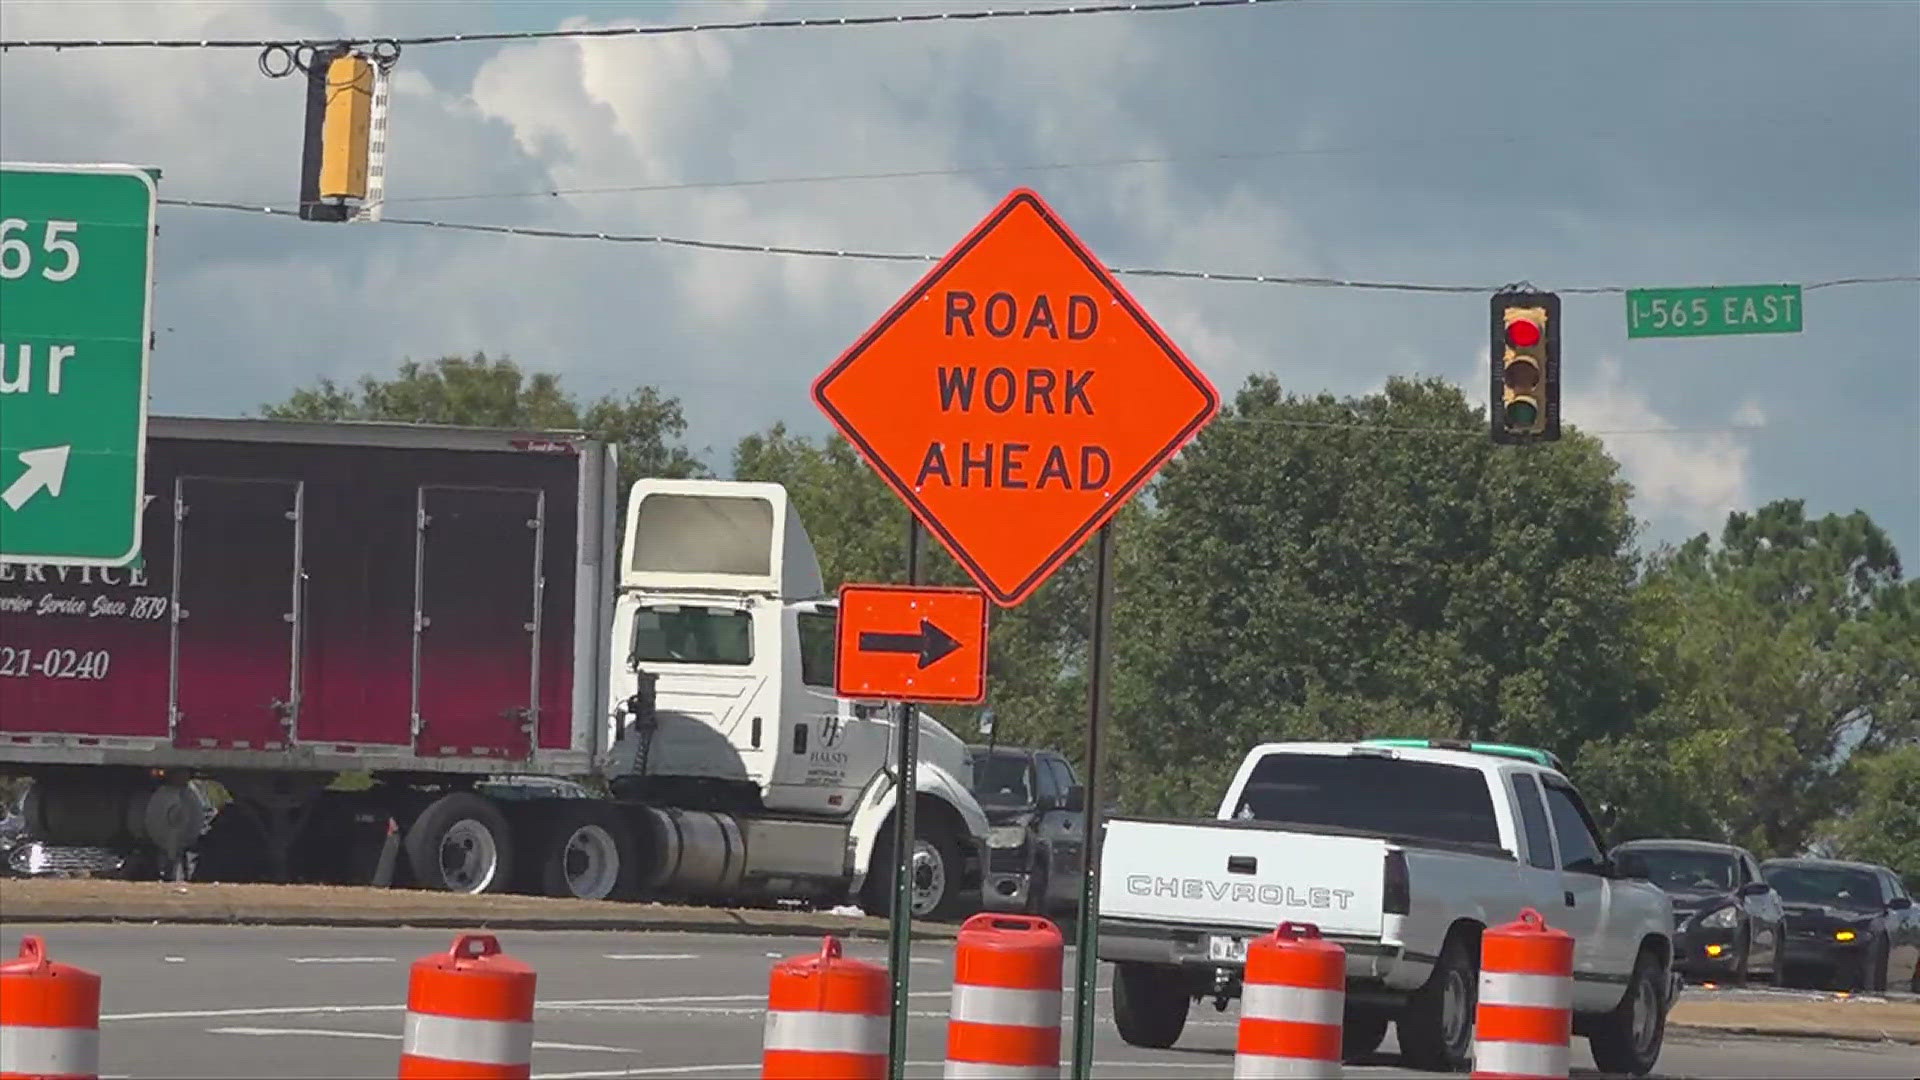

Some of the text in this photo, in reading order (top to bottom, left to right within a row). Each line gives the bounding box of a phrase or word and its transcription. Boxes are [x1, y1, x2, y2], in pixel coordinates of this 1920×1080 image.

[0, 218, 80, 282] 65
[945, 291, 1098, 340] ROAD
[1632, 295, 1795, 329] I-565 EAST
[0, 343, 76, 395] ur
[938, 366, 1095, 416] WORK
[915, 442, 1111, 491] AHEAD
[36, 593, 87, 616] Service
[89, 594, 126, 617] Since
[129, 597, 168, 620] 1879
[1127, 874, 1354, 910] CHEVROLET
